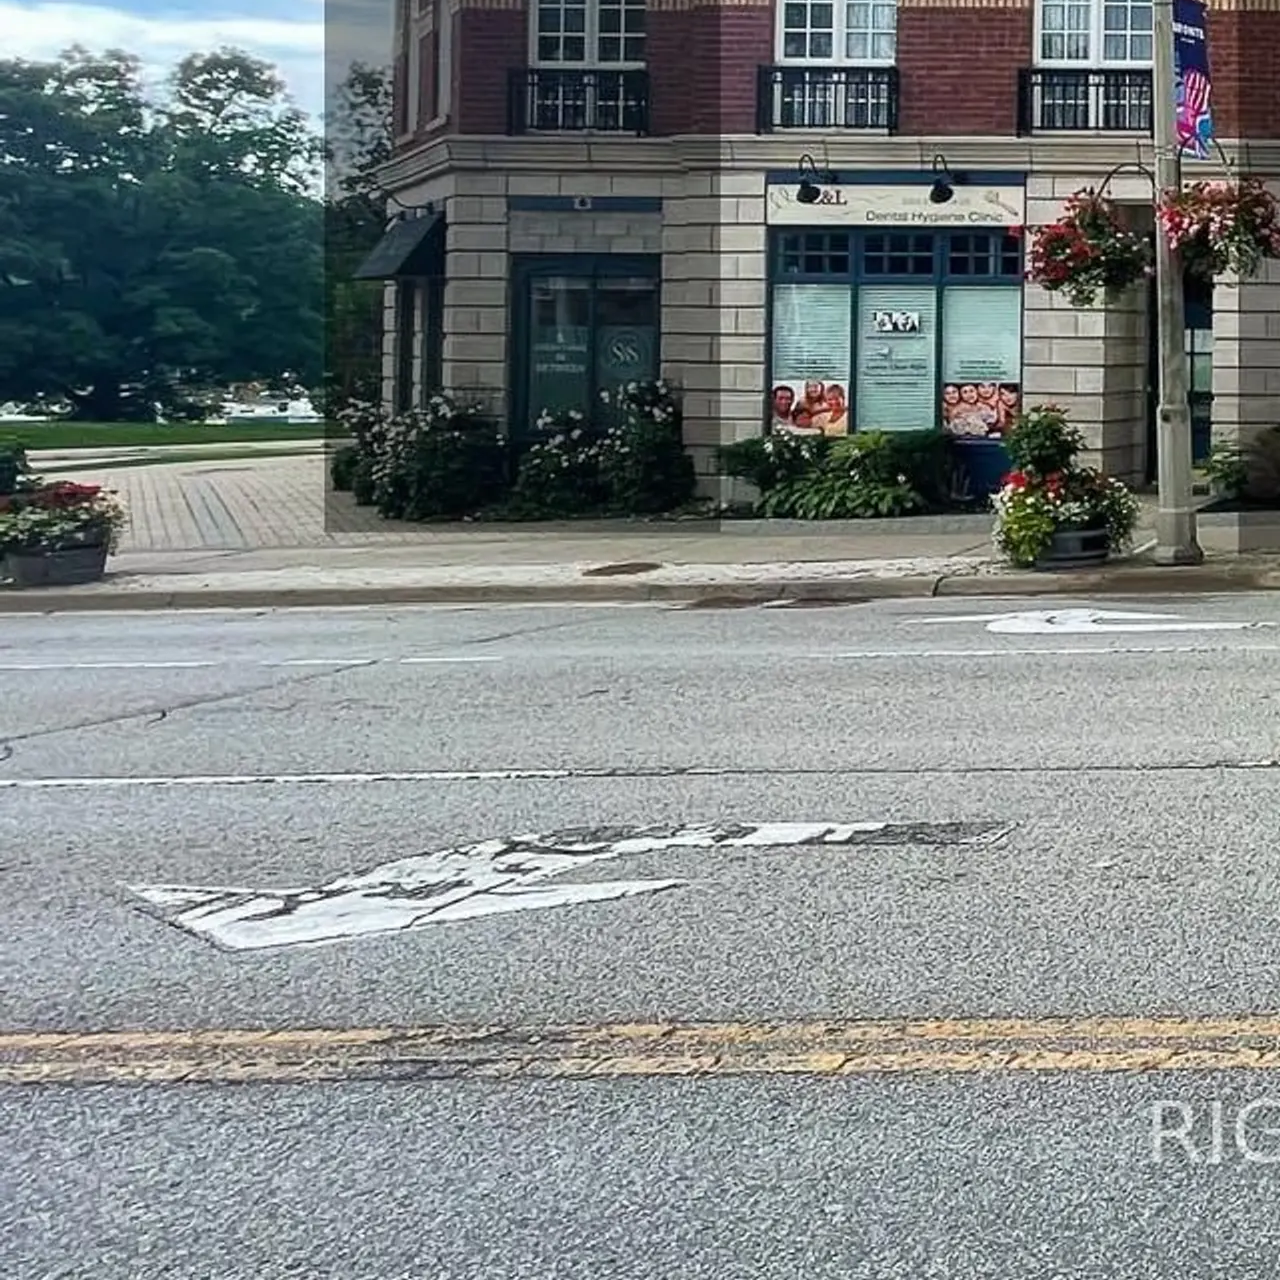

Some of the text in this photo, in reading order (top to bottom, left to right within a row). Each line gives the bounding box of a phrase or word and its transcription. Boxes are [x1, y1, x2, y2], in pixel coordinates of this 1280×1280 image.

[865, 210, 1003, 224] Dental Hygiene Clinic
